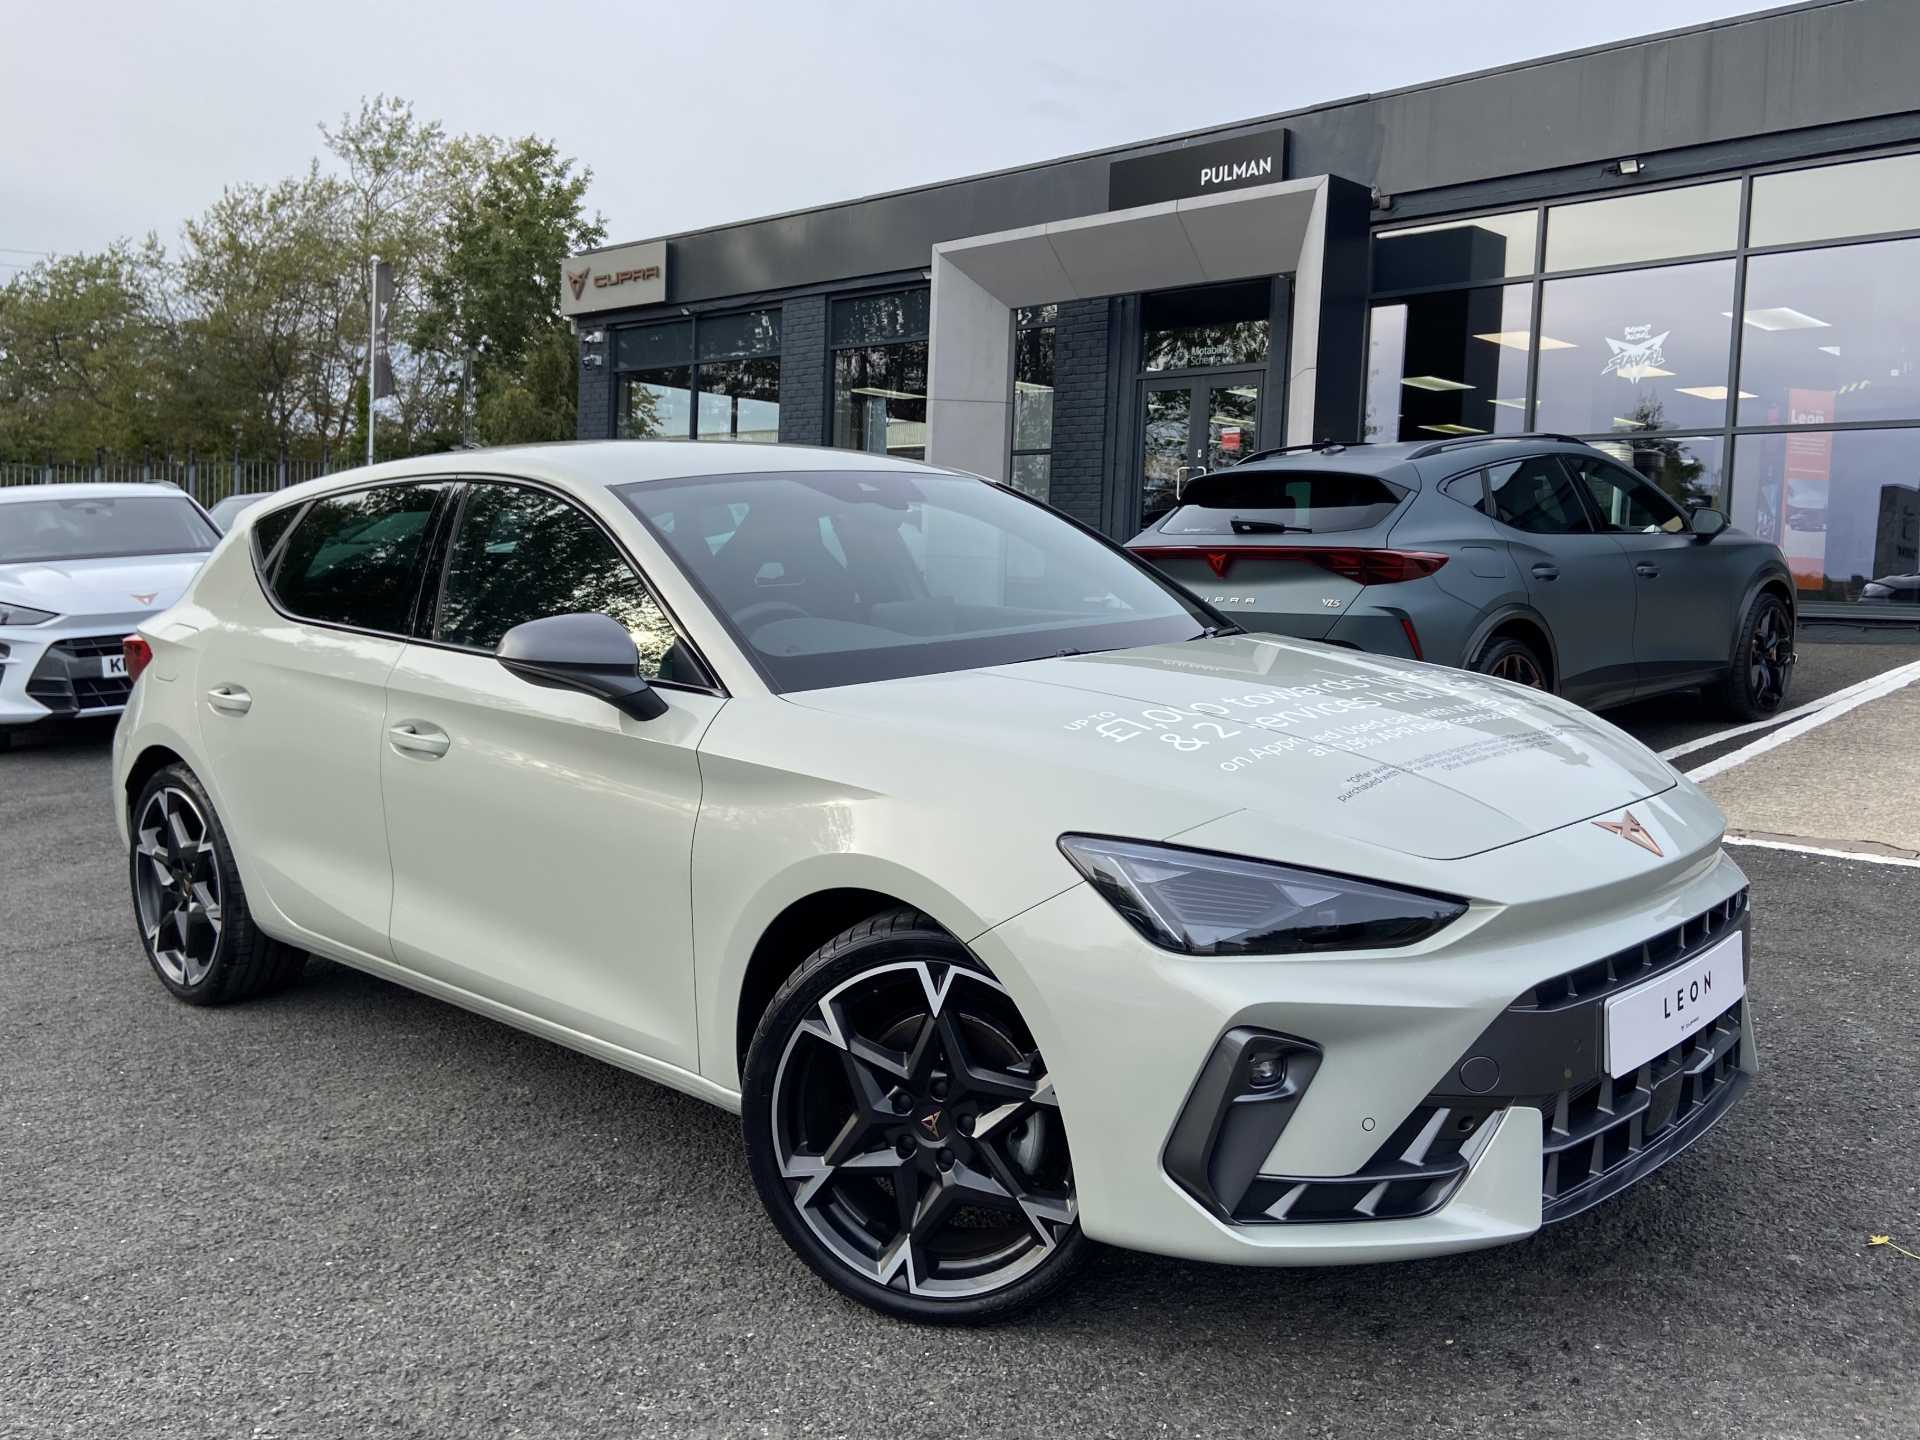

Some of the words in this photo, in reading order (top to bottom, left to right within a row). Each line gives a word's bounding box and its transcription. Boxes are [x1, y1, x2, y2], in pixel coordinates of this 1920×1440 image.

[1201, 156, 1272, 186] PULMAN
[593, 265, 660, 288] CUPRA
[1221, 678, 1370, 708] towards
[1064, 718, 1089, 731] UP
[1088, 711, 1116, 721] TO
[1160, 732, 1210, 752] &
[1191, 721, 1241, 739] 2
[1219, 754, 1253, 772] on
[1250, 729, 1342, 760] Appred
[1308, 744, 1337, 757] at
[1664, 970, 1712, 1019] LEON
